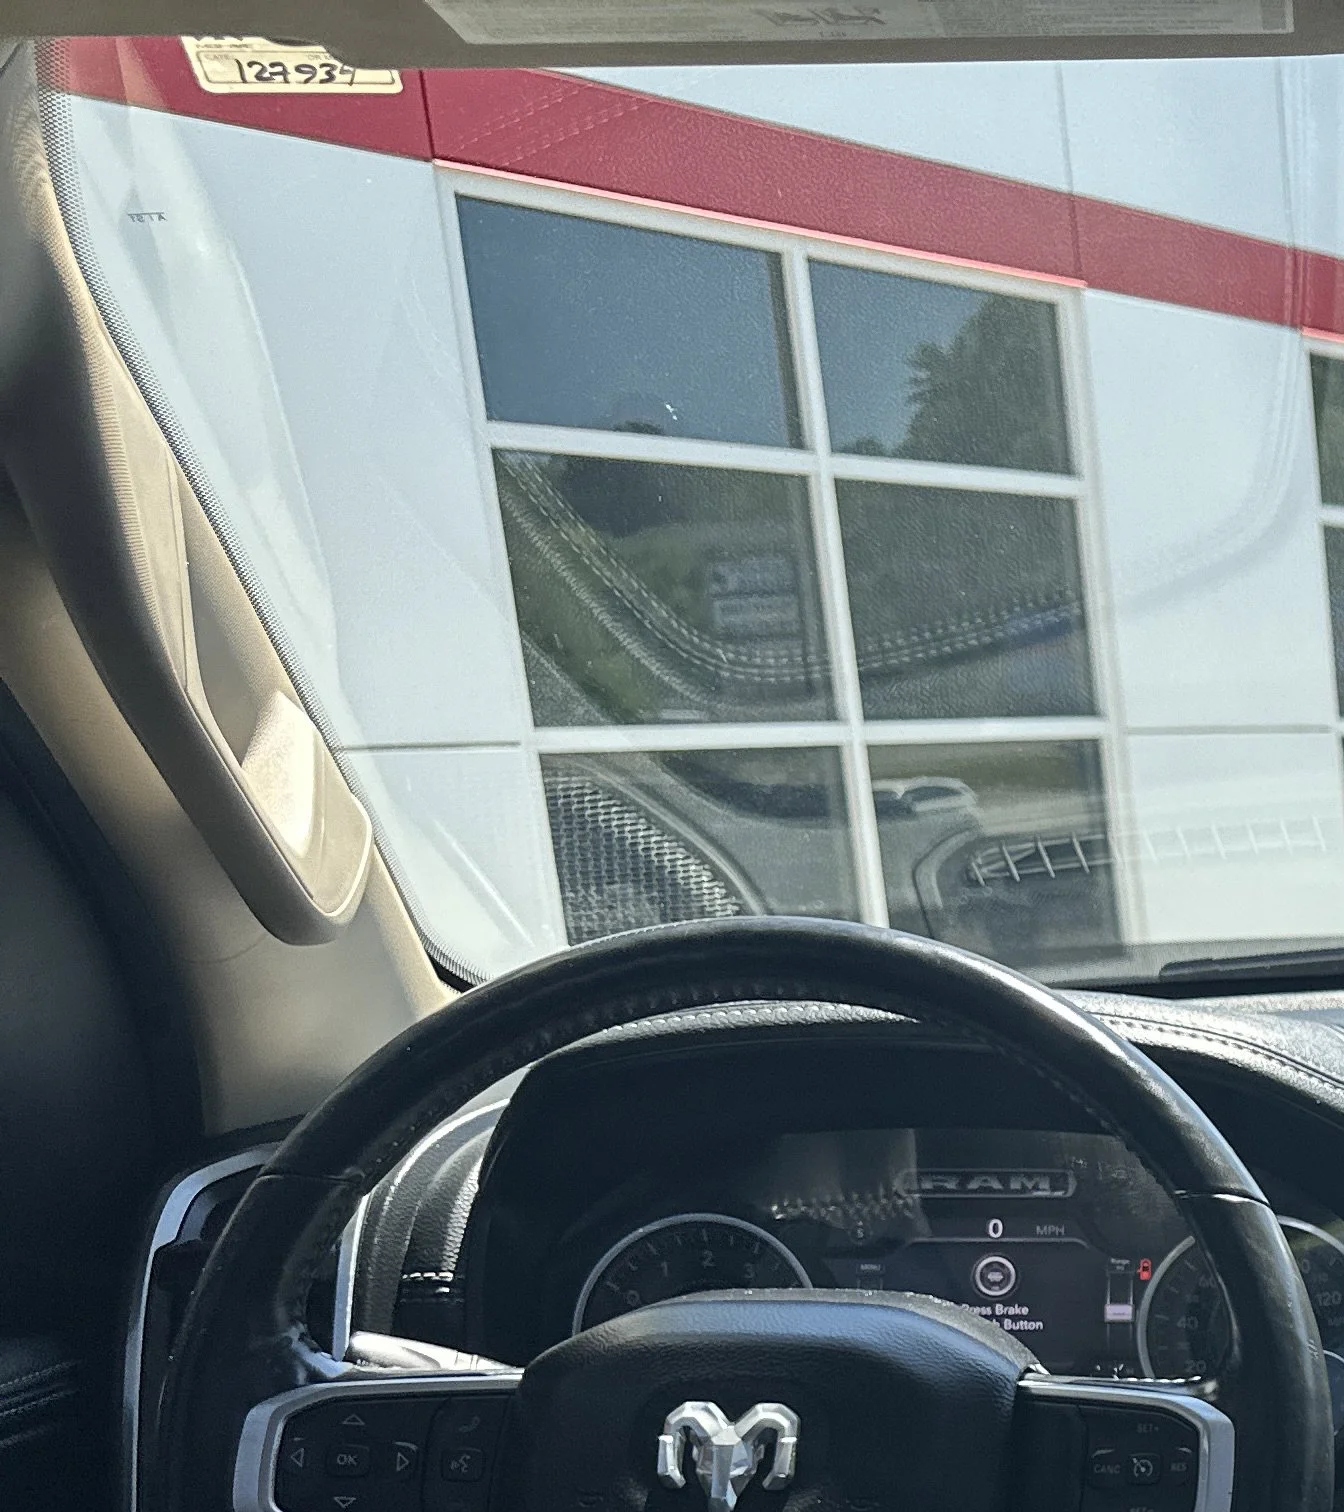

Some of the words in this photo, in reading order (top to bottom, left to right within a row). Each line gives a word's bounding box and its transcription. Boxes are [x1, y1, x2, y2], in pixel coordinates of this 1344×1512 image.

[987, 1218, 1004, 1239] 0
[1035, 1224, 1066, 1237] MPH
[994, 1303, 1030, 1316] Brake
[1003, 1318, 1044, 1331] Button
[1176, 1315, 1200, 1330] 40
